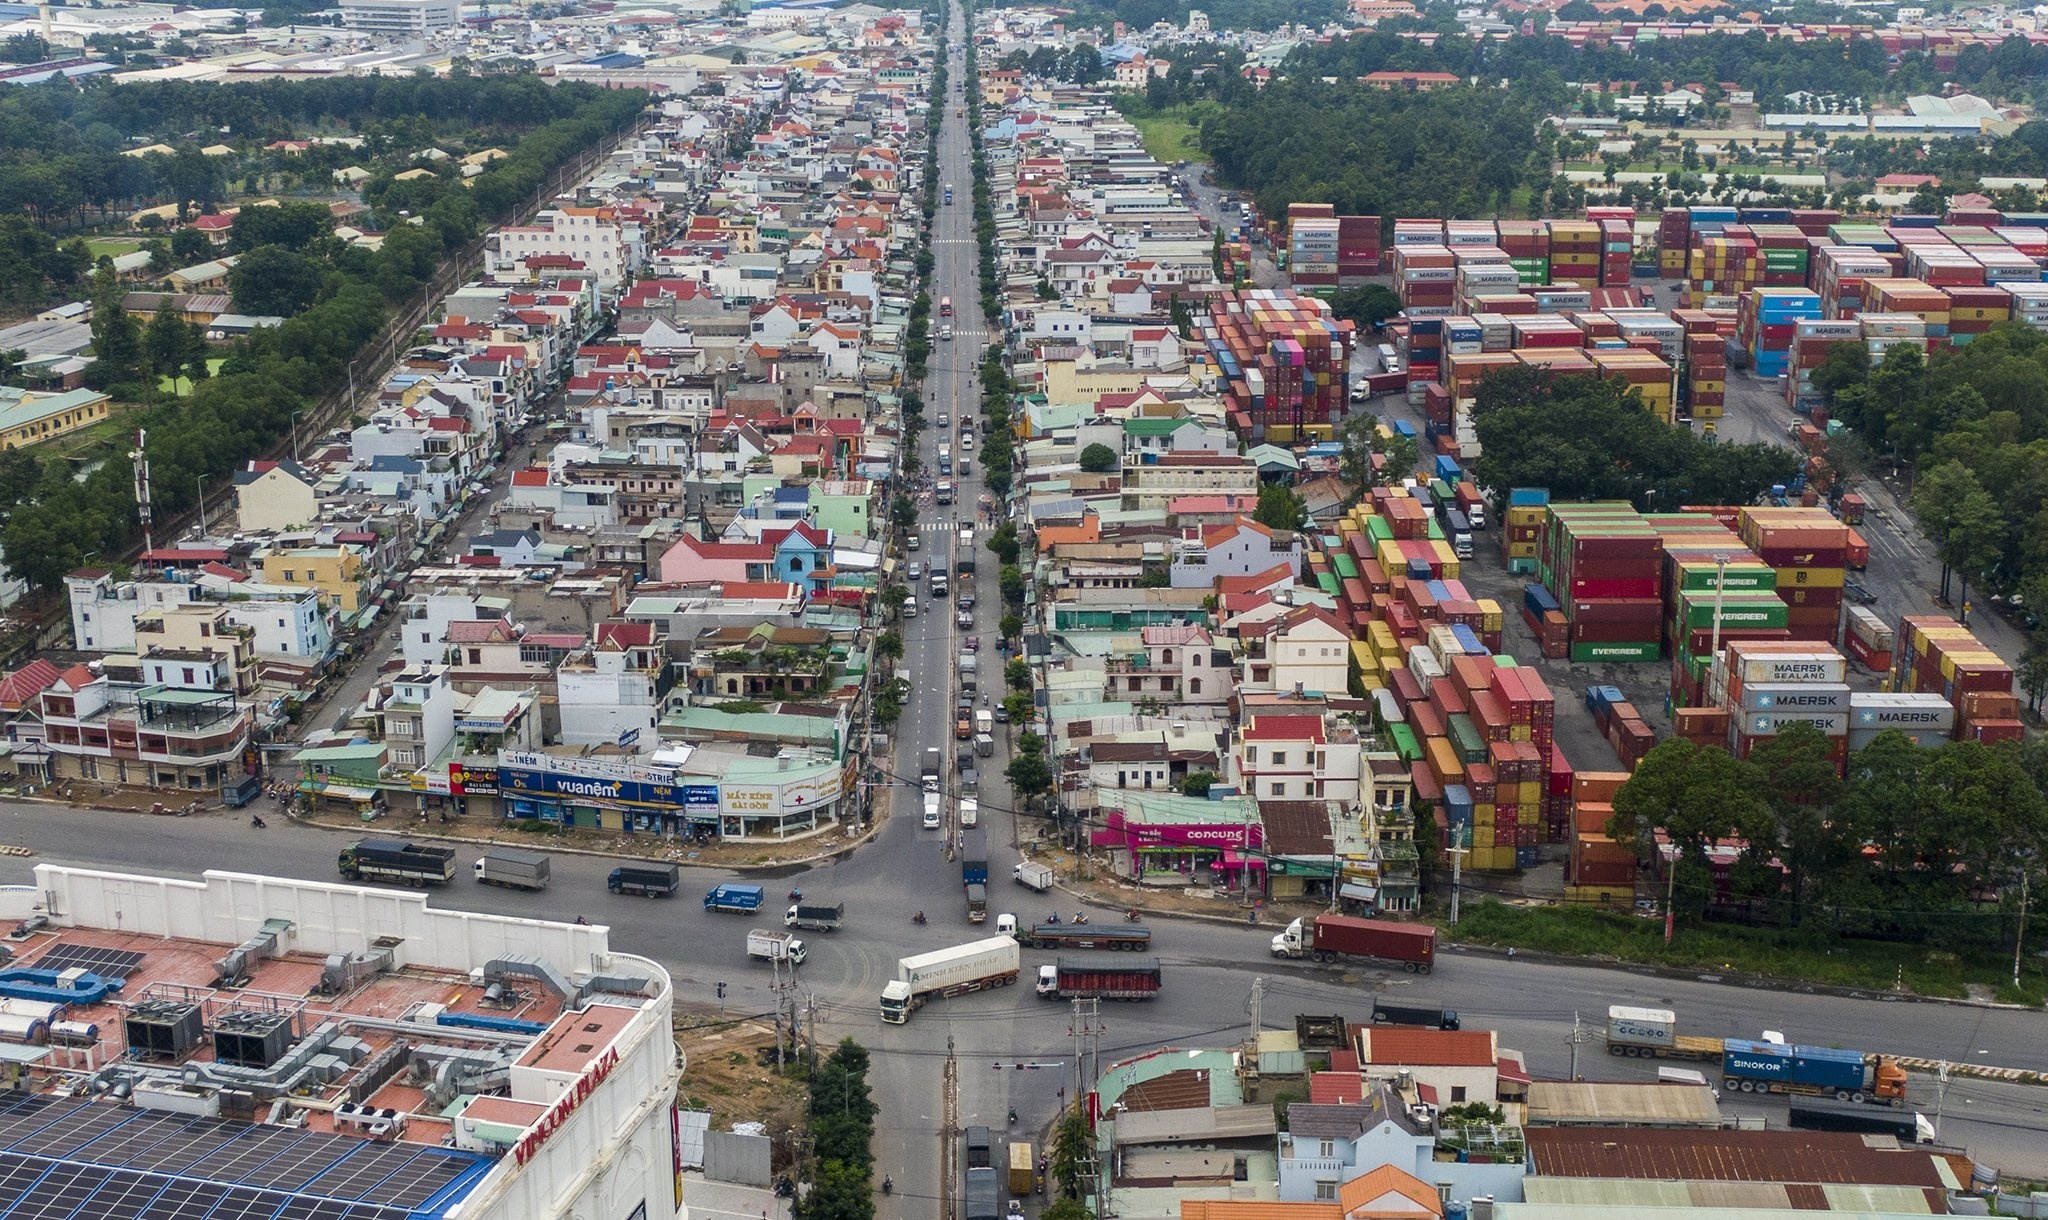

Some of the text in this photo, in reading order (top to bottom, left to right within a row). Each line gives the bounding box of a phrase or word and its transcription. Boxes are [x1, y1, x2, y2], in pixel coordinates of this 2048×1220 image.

[1774, 664, 1825, 672] MAERSK
[1776, 696, 1837, 706] MAERSK
[1879, 712, 1940, 722] MAERSK
[1187, 830, 1243, 841] concung
[1733, 1060, 1781, 1072] SINOKOR
[514, 1045, 620, 1167] VINCOM PLAZA
